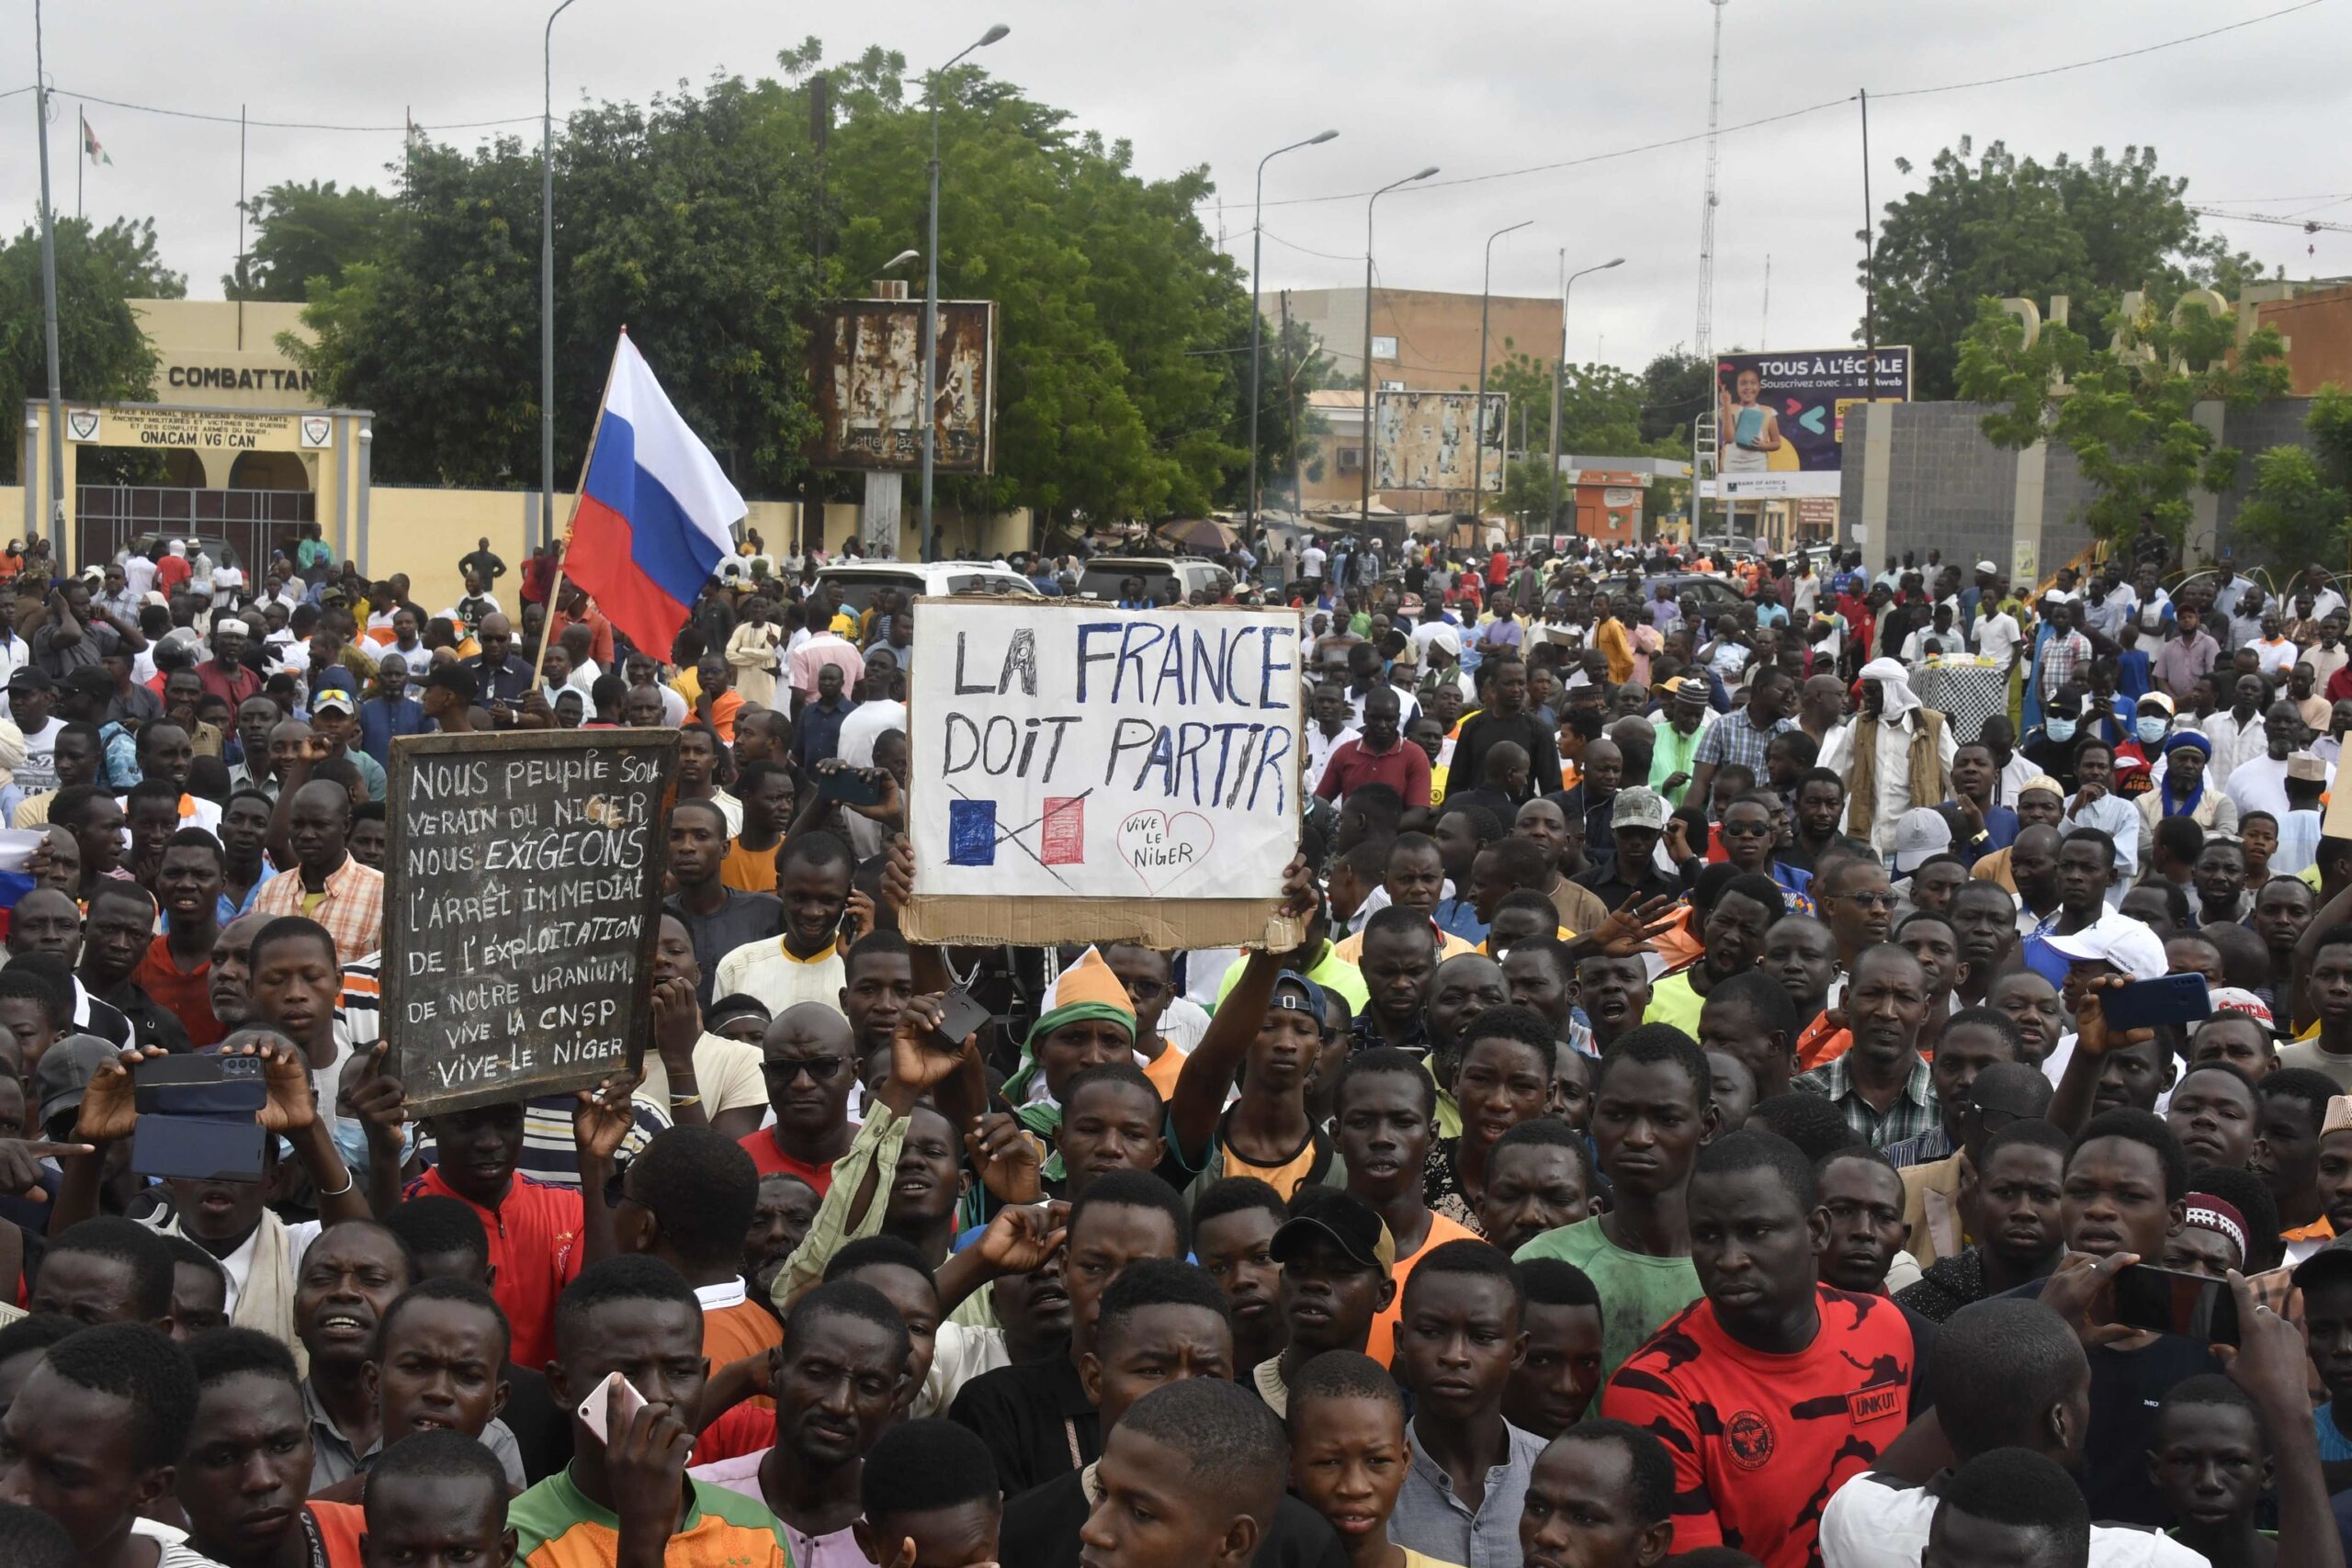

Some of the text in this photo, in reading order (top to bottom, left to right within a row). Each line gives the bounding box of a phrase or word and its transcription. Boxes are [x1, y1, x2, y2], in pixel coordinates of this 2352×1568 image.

[1758, 361, 1809, 376] TOUS
[1812, 357, 1826, 375] À
[1760, 378, 1814, 389] Souscrivez
[1815, 379, 1840, 388] avec
[149, 417, 190, 425] MILITAIRES
[259, 422, 288, 430] GUERRE
[199, 412, 231, 420] ANCIENS
[955, 622, 1295, 709] LA FRANCE
[412, 761, 489, 800] NOUS
[407, 791, 649, 837] VERAIN DU NIGER
[1146, 832, 1161, 844] LE
[409, 846, 475, 877] NOUS
[409, 951, 447, 976] DE
[407, 1000, 438, 1023] DE
[508, 1010, 526, 1036] LA
[538, 998, 616, 1030] CNSP
[512, 1043, 534, 1072] LE
[1857, 1392, 1895, 1416] UNKUT
